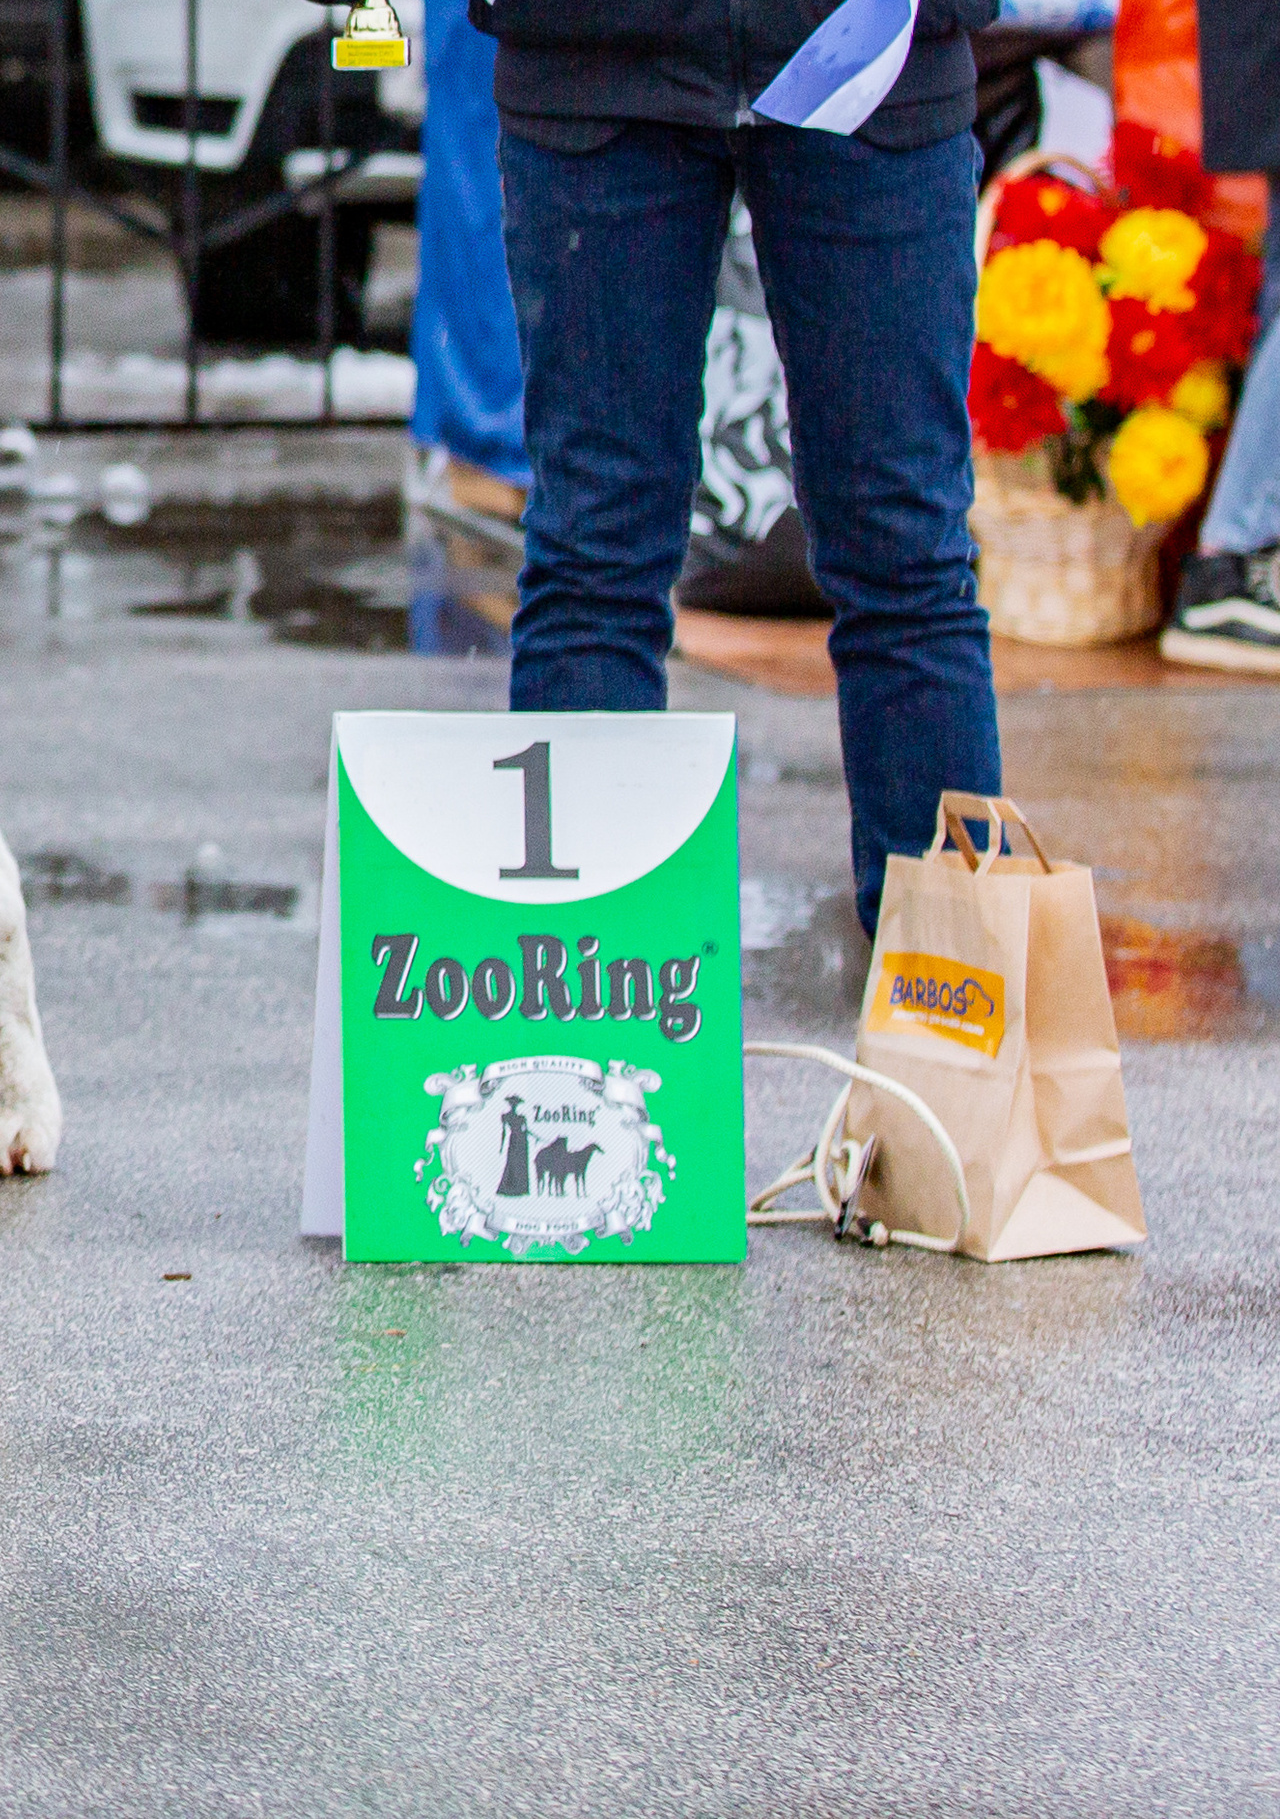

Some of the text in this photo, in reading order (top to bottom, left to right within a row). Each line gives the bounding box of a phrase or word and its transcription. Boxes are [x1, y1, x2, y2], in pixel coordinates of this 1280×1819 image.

[493, 740, 580, 880] 1
[889, 975, 968, 1016] BARBOS
[499, 1059, 585, 1072] HIGH QUALITY
